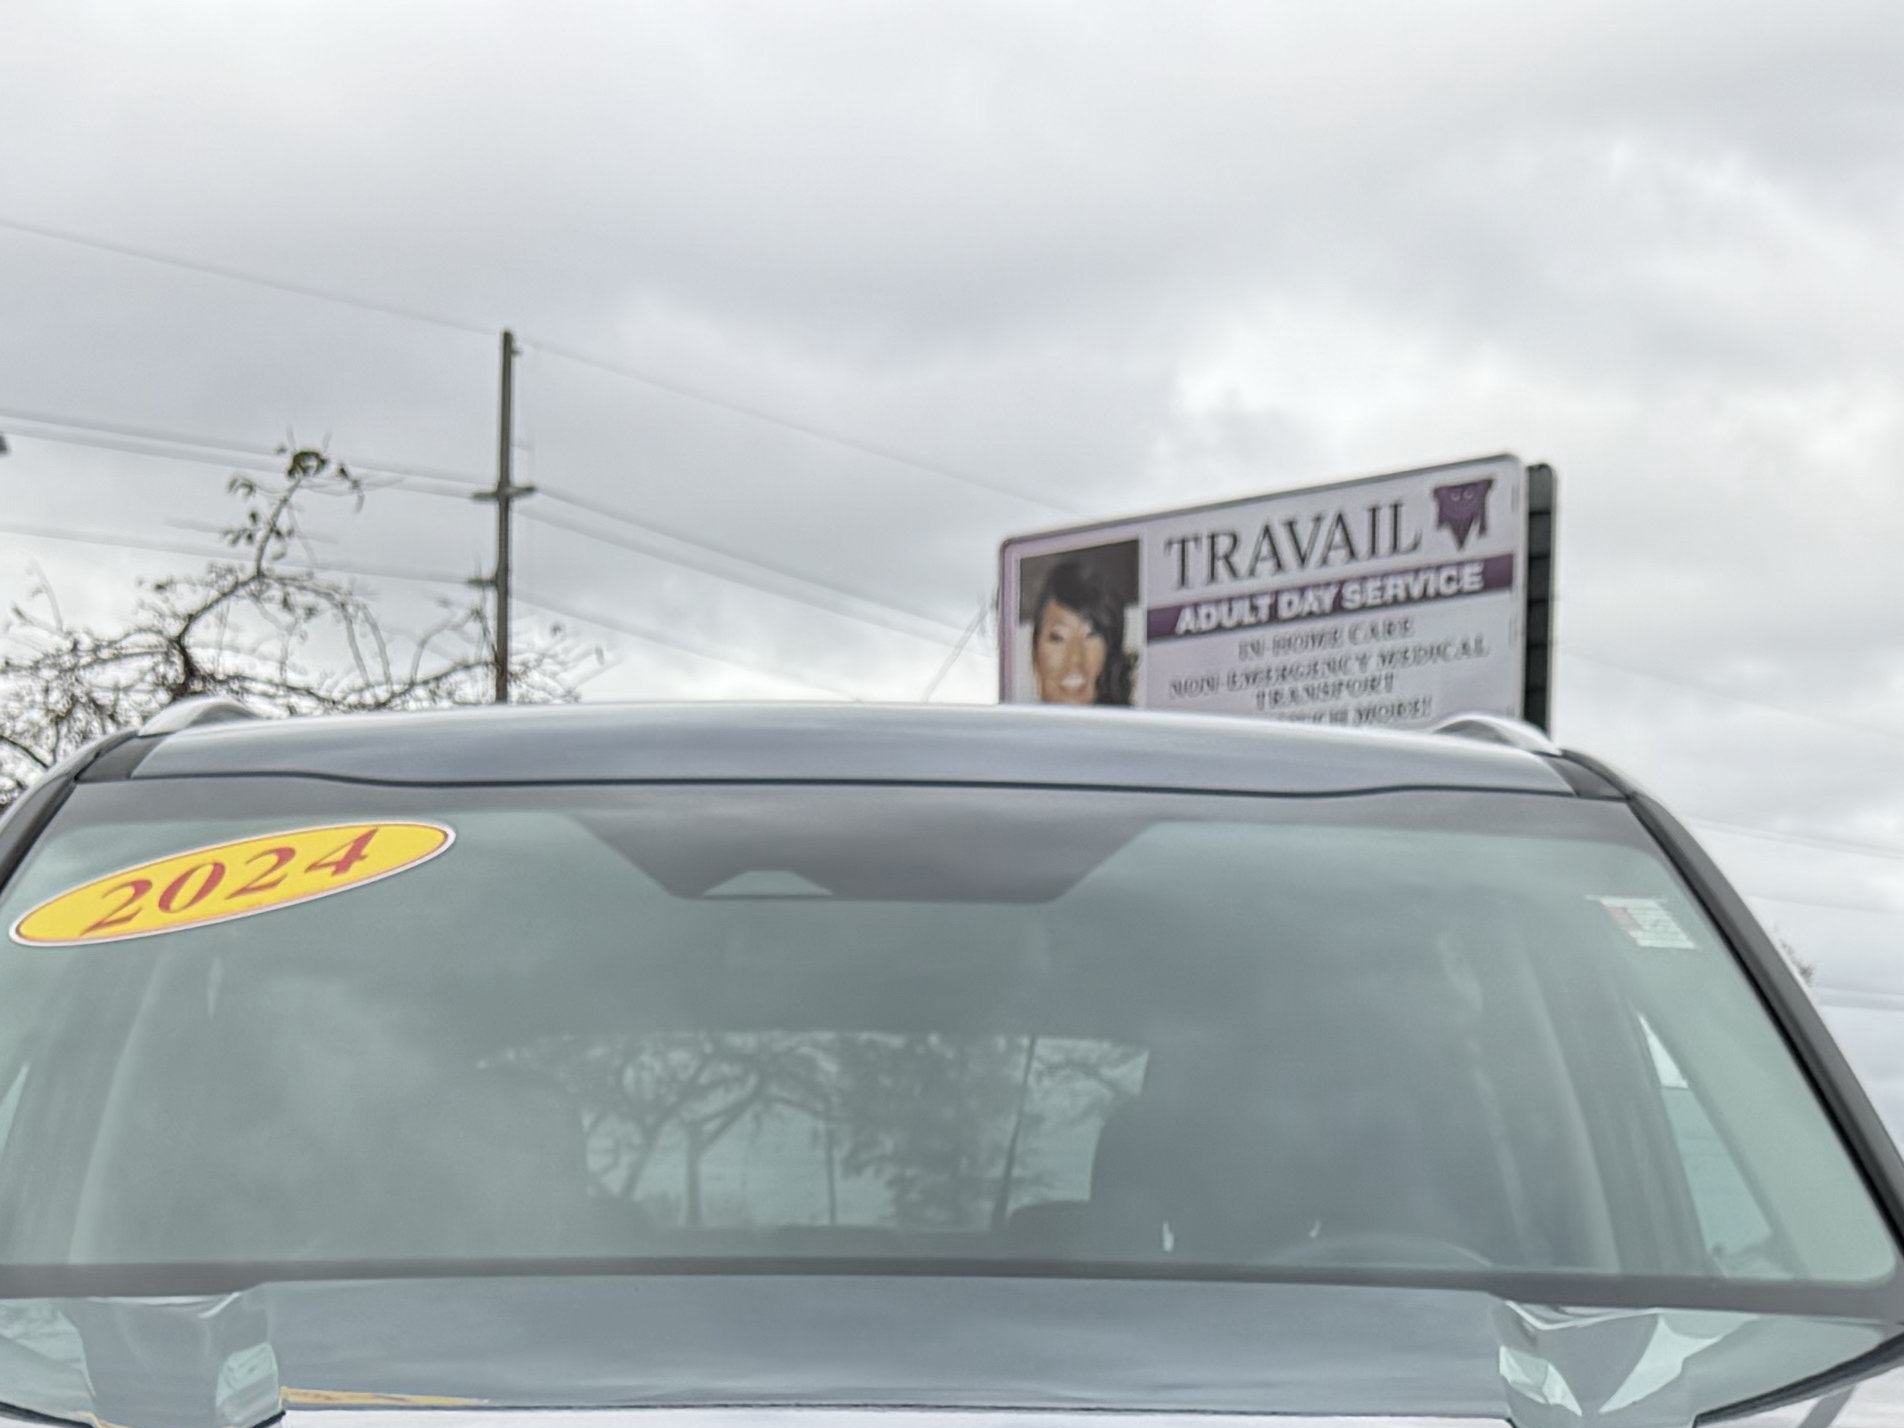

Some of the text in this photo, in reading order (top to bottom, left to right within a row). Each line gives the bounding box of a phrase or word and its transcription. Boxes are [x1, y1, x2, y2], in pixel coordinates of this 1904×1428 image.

[1163, 500, 1423, 590] TRAVAIL
[1175, 562, 1485, 636] ADULT DAY SERVICE
[1348, 616, 1415, 646] CARE
[1376, 634, 1490, 669] MEDICAL
[1255, 670, 1395, 712] TRANSPORT
[79, 827, 380, 937] 2024
